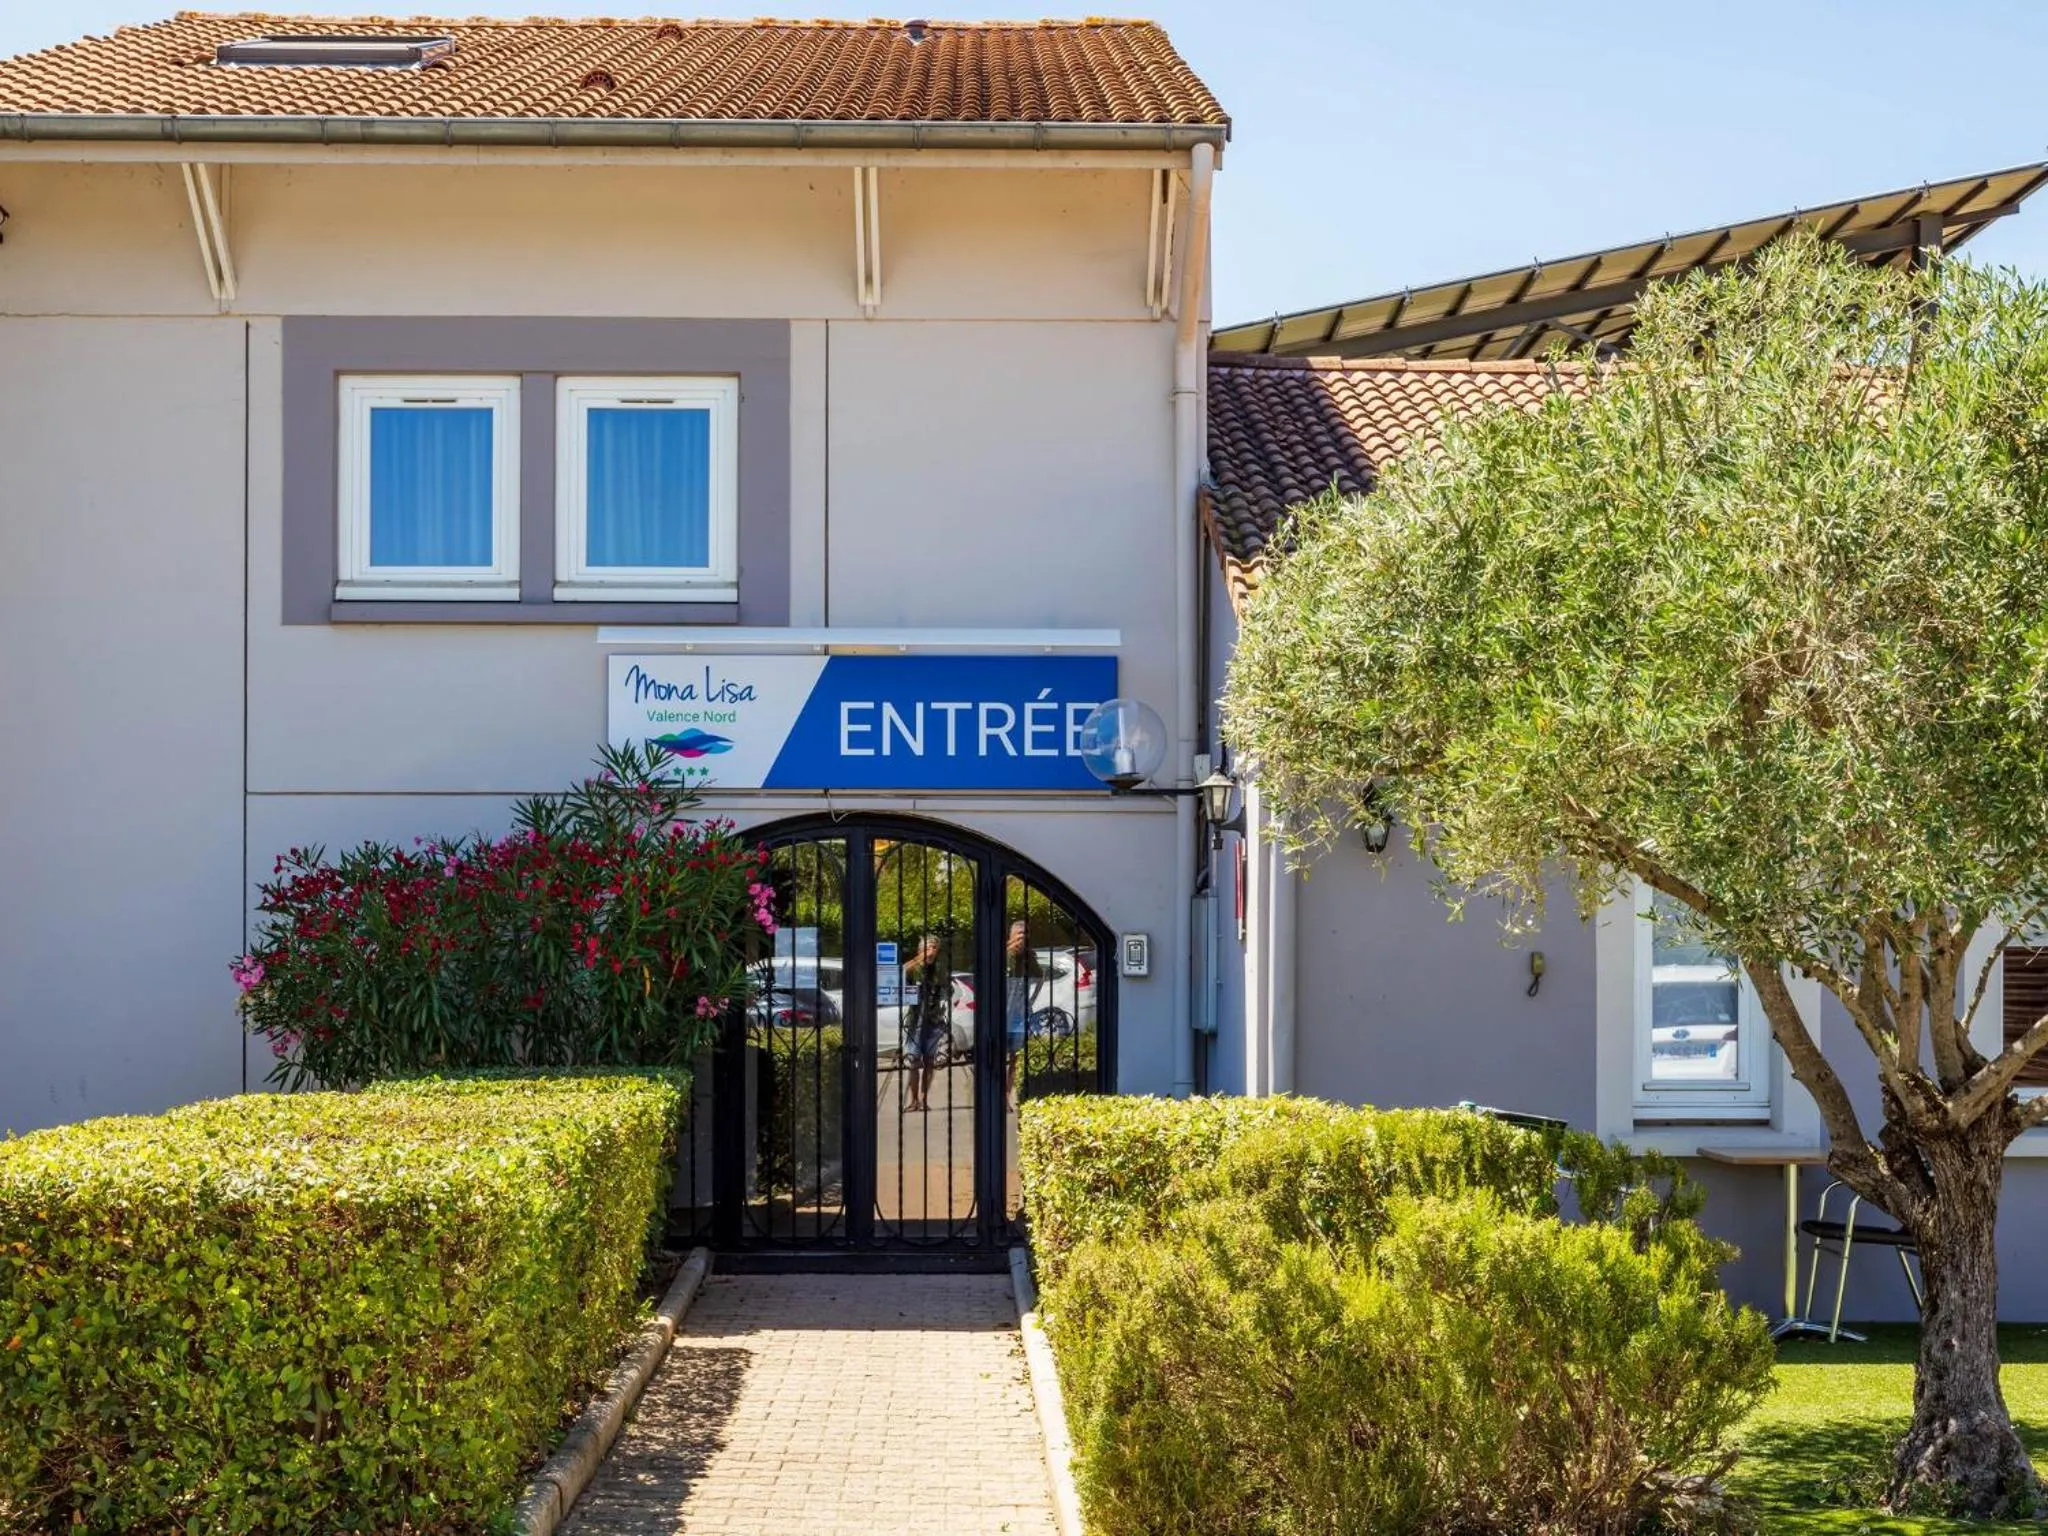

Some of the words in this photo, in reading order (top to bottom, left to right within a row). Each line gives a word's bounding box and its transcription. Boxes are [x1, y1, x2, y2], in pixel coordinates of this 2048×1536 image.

[624, 664, 699, 704] Mona
[705, 665, 757, 704] Lisa
[646, 709, 700, 722] Valence
[703, 709, 737, 723] Nord
[840, 687, 1102, 757] ENTRÉE
